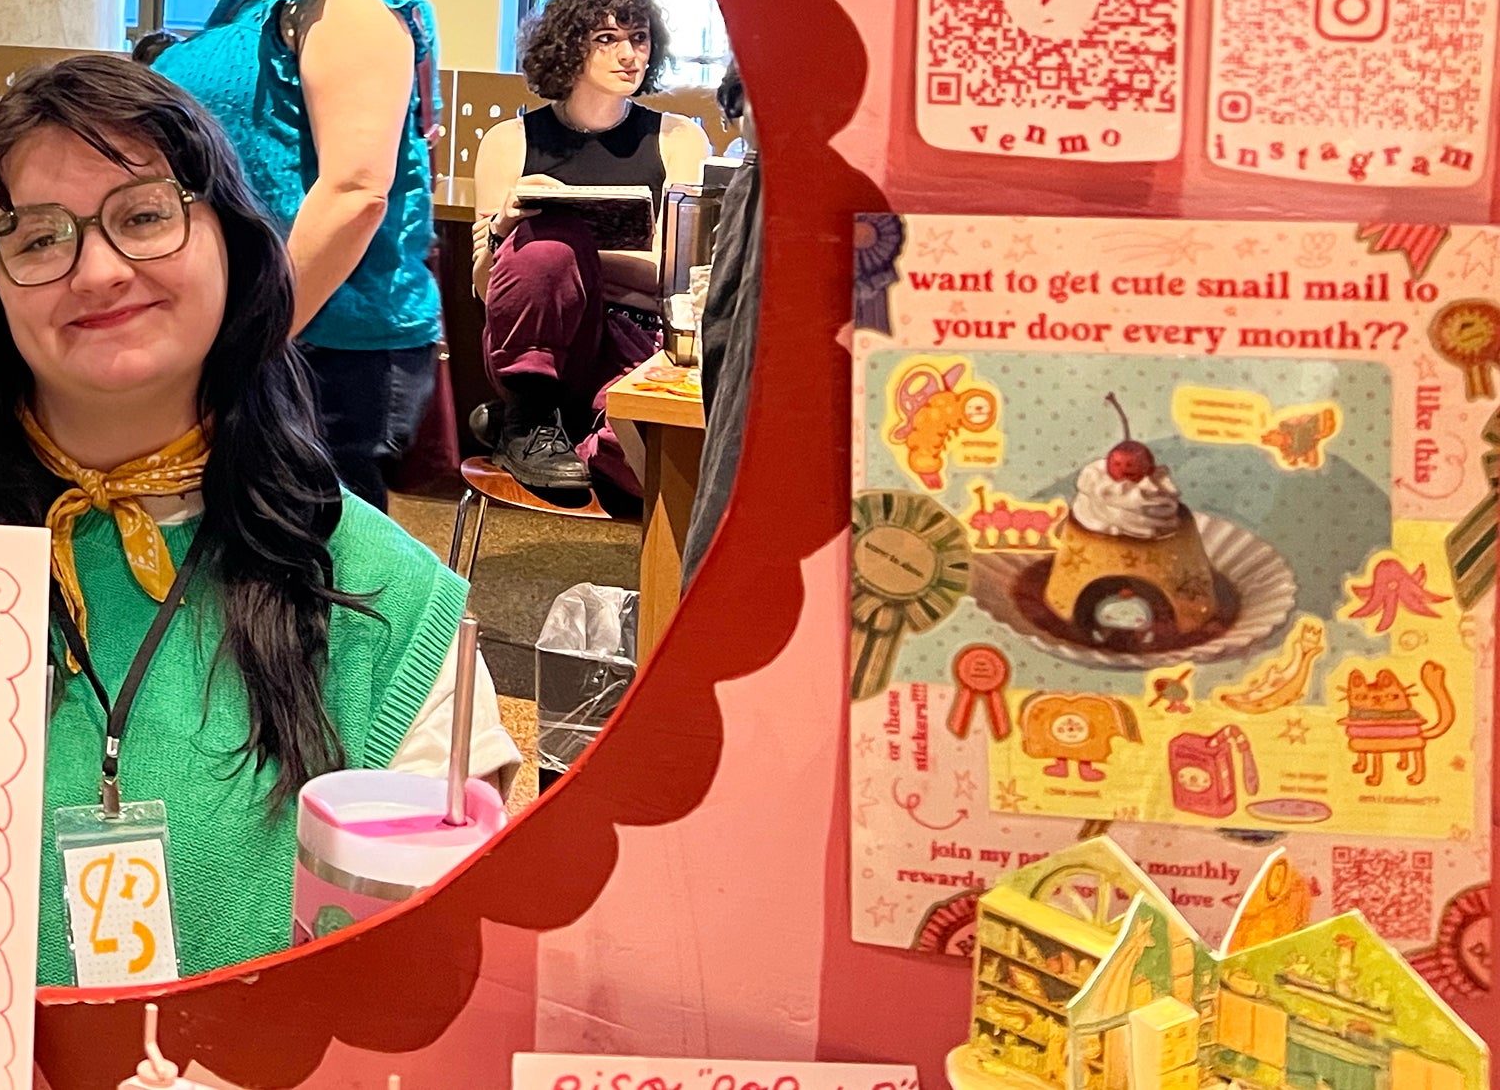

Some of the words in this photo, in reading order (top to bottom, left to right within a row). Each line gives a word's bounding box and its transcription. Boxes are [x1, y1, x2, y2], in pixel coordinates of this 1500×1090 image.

[970, 122, 1121, 155] venmo
[1215, 135, 1473, 181] instagram
[909, 270, 994, 295] want
[1005, 271, 1037, 294] to
[1049, 272, 1100, 302] get
[1112, 271, 1187, 297] cute
[1198, 273, 1289, 301] snail
[1304, 272, 1389, 302] mail
[1405, 279, 1438, 303] to
[932, 316, 1015, 347] your
[1027, 314, 1110, 341] door
[1123, 318, 1225, 352] every
[1238, 321, 1408, 351] month??
[1416, 385, 1441, 430] like
[1415, 439, 1439, 483] this
[883, 690, 900, 734] these
[889, 741, 900, 761] or
[930, 840, 972, 861] join
[980, 850, 1011, 867] my
[1147, 861, 1241, 885] monthly
[897, 869, 985, 887] rewards
[1170, 887, 1214, 908] love
